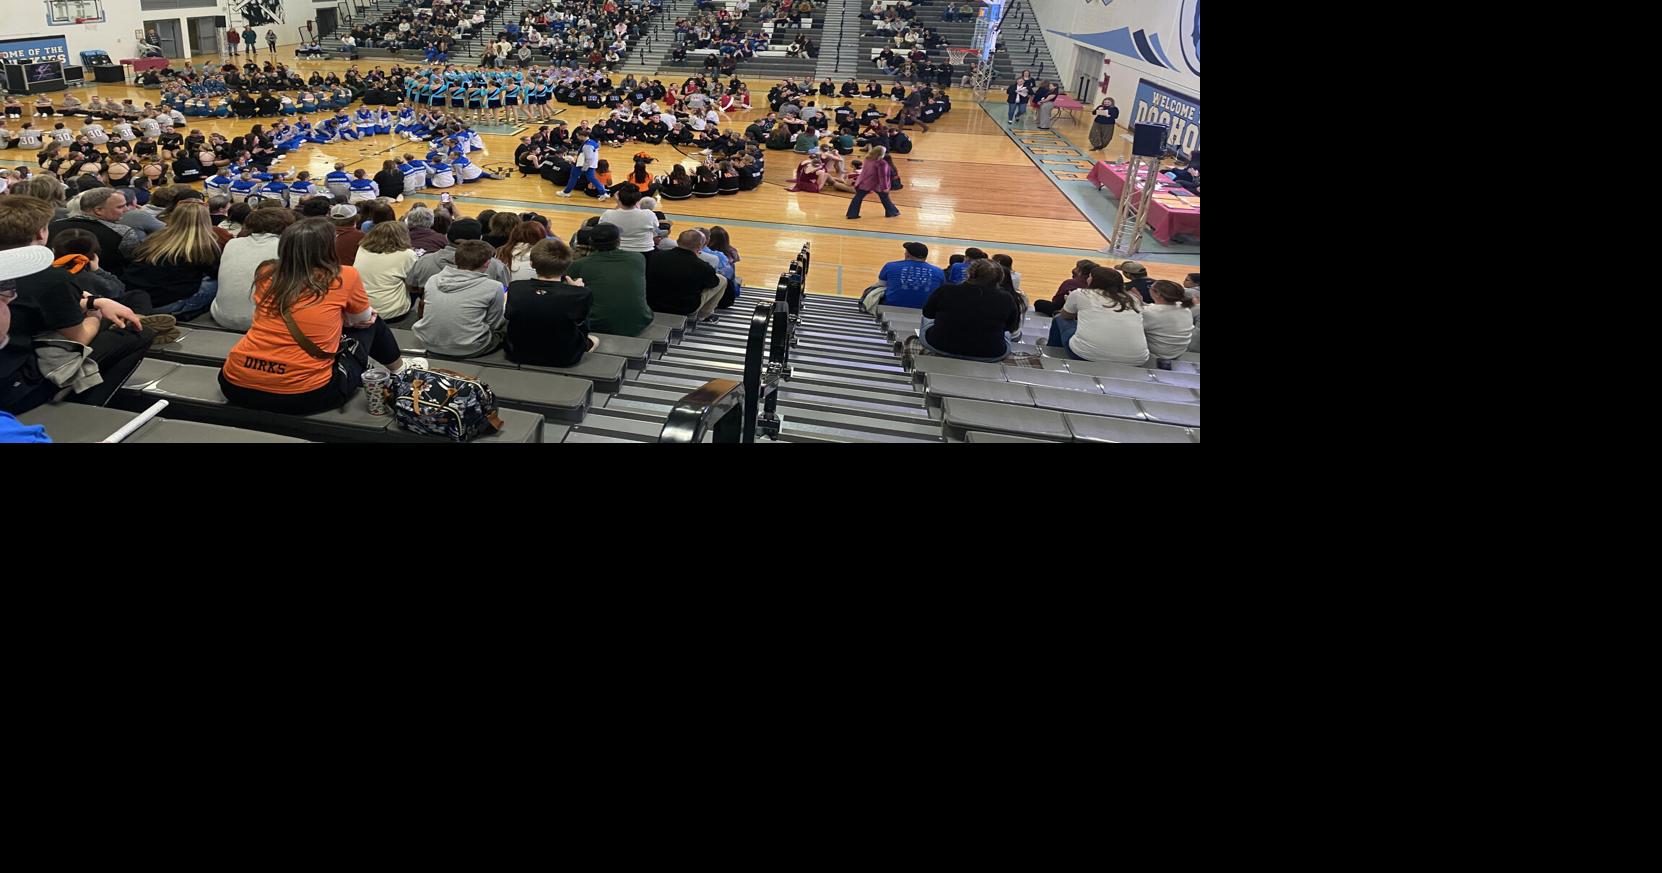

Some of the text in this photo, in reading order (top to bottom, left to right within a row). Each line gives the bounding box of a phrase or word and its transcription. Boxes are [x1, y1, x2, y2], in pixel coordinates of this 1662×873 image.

[2, 45, 64, 58] OME OF THE
[1152, 91, 1196, 120] WELCOME
[56, 132, 71, 141] 30
[88, 129, 103, 139] 30
[20, 136, 35, 145] 30
[243, 355, 287, 375] DIRKS
